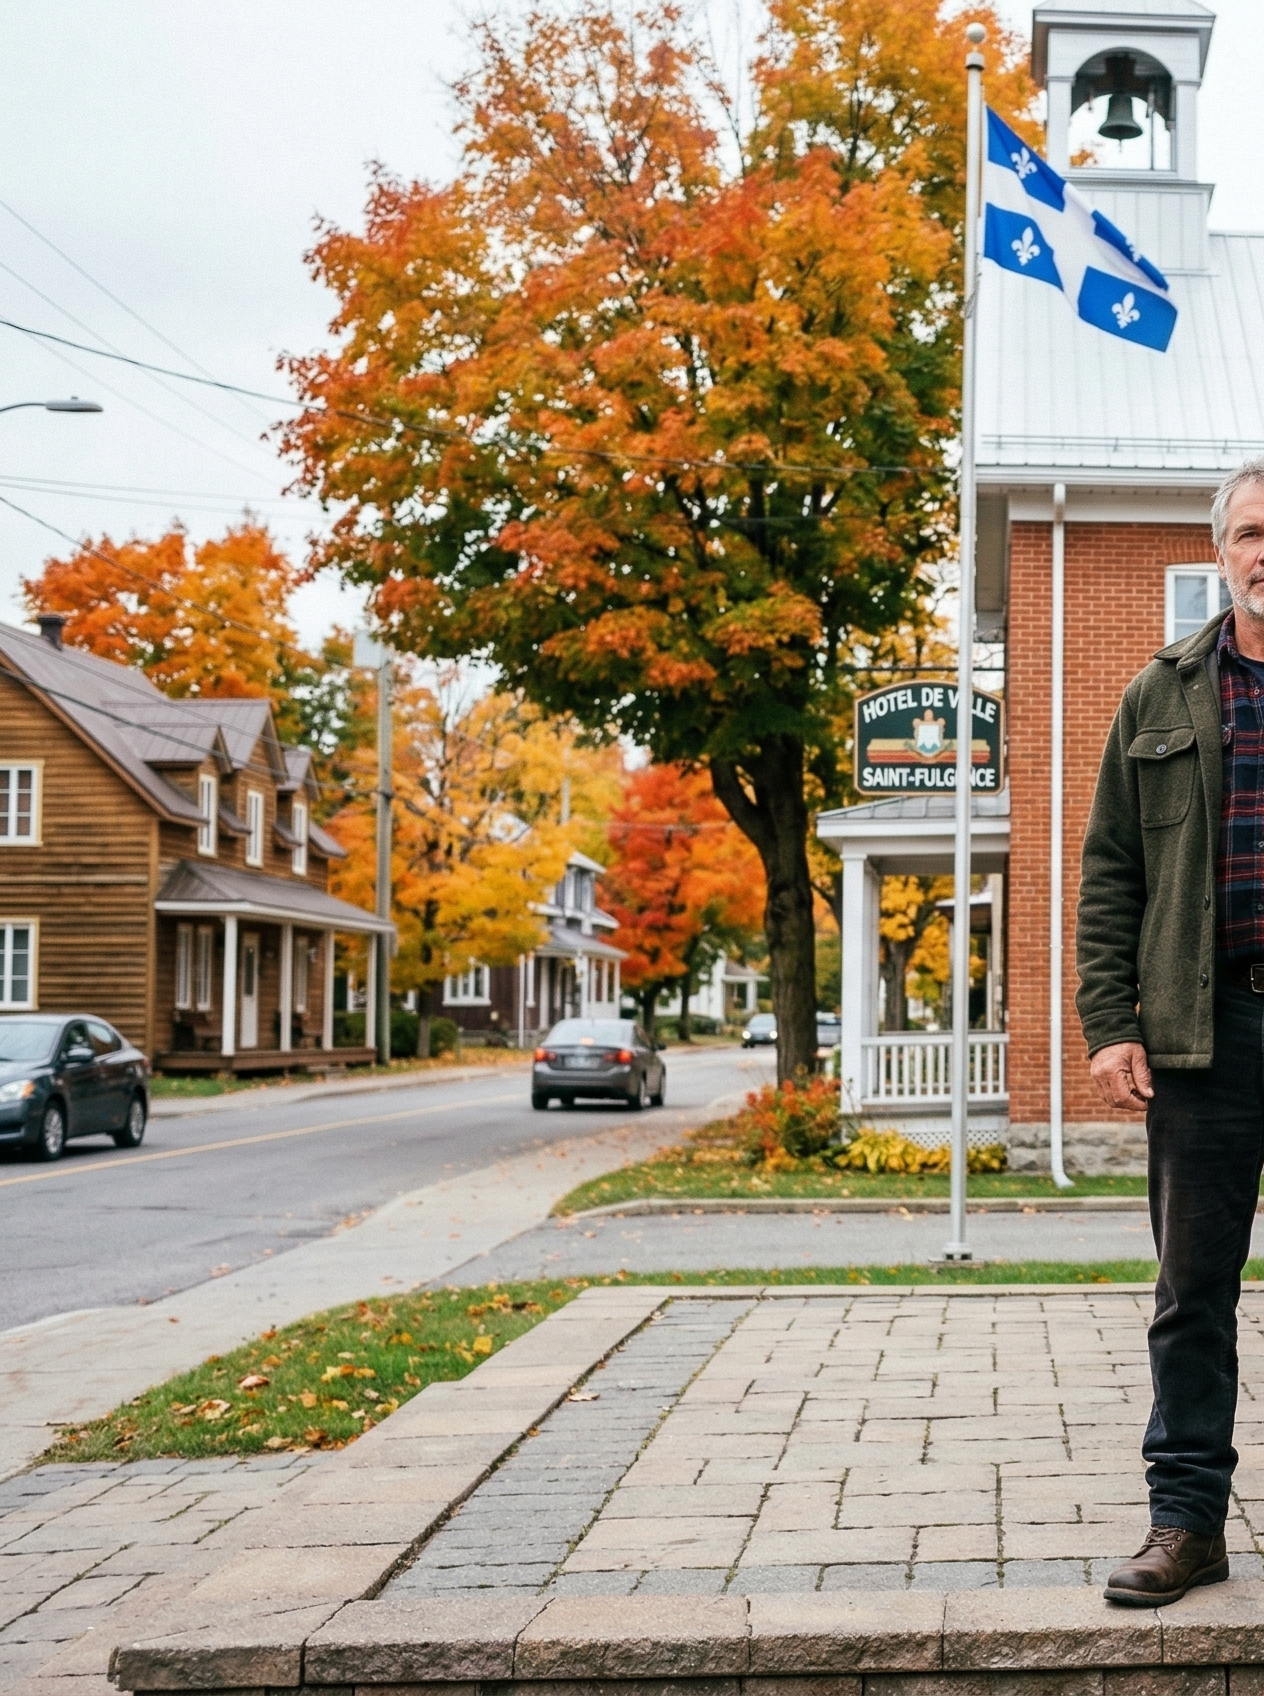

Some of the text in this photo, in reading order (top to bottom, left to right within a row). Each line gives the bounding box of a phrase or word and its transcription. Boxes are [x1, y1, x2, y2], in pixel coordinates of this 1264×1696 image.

[862, 687, 996, 723] HOTEL DE VLE
[862, 767, 996, 787] SAINT-FULGNCE
